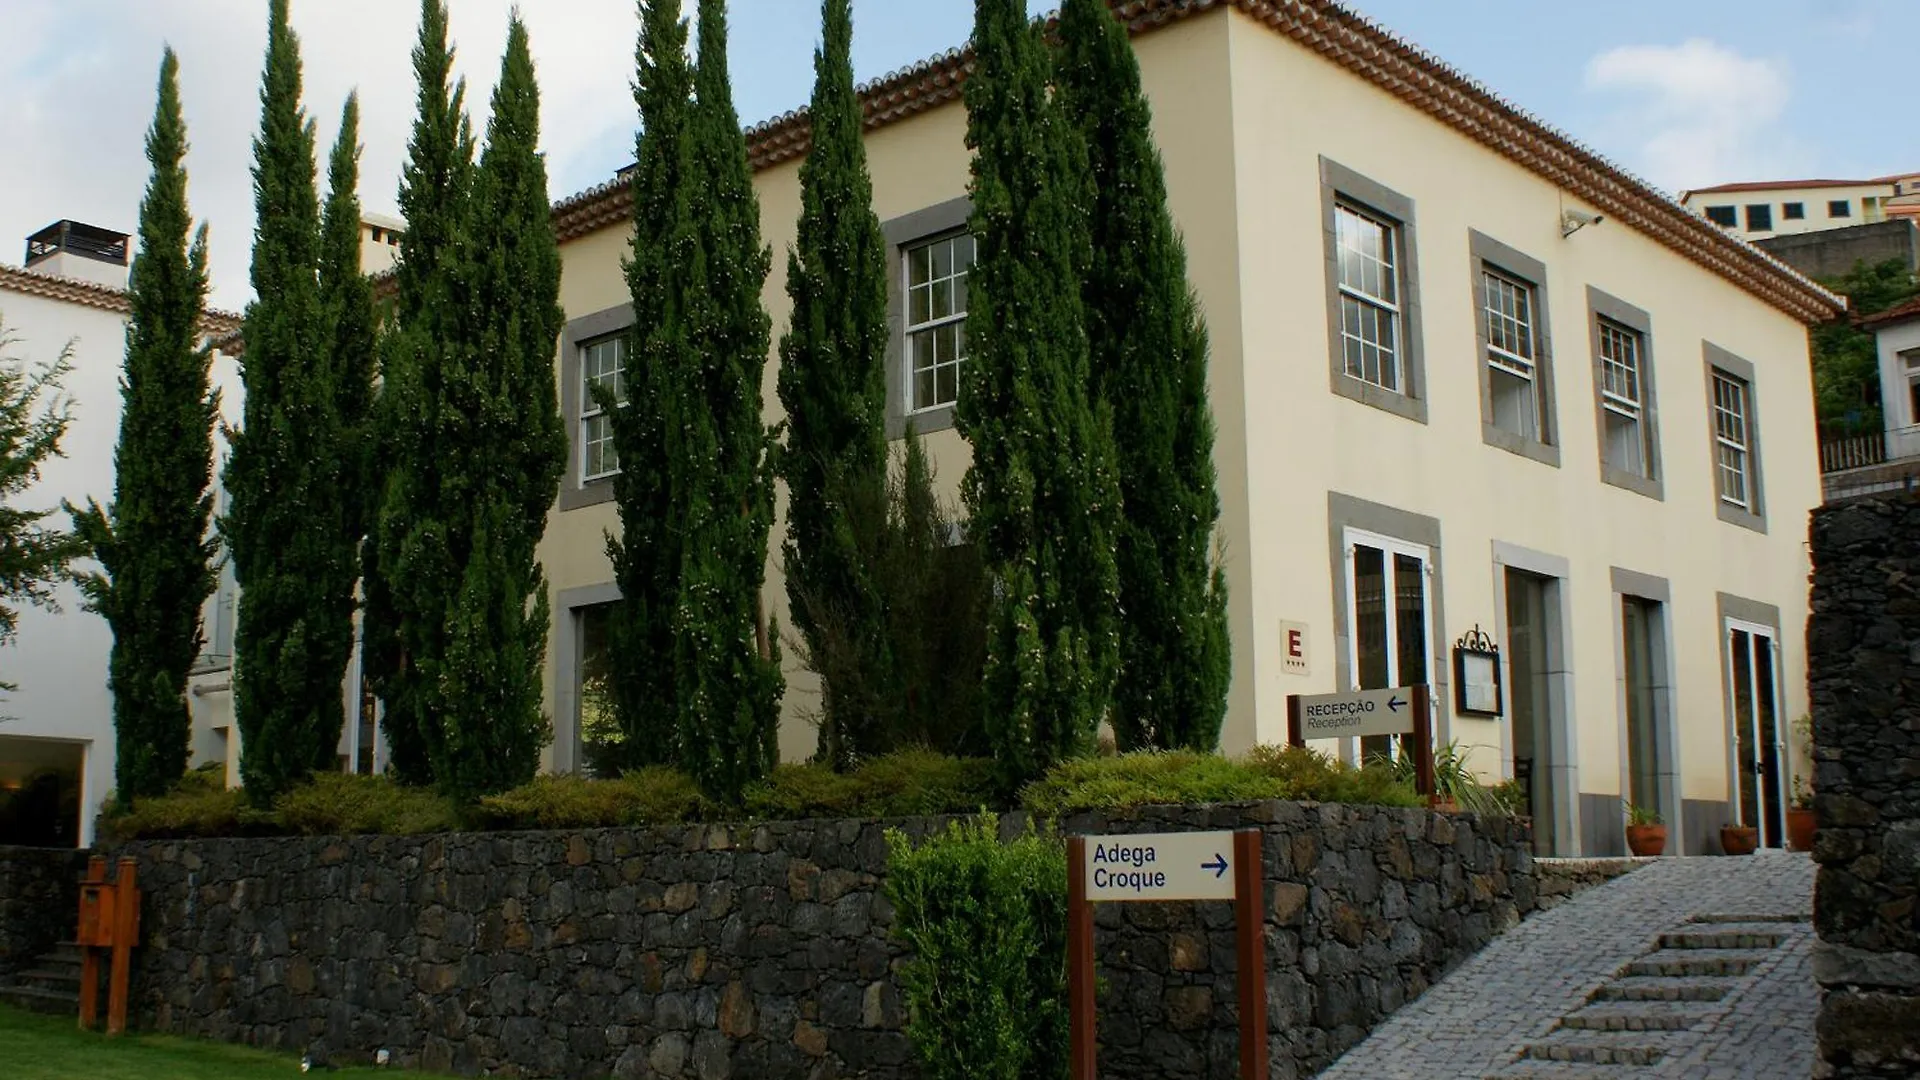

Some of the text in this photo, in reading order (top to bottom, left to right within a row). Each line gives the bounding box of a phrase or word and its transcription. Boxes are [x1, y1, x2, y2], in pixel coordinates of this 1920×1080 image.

[1289, 630, 1301, 657] E
[1306, 700, 1375, 717] RECEPÇÃO
[1307, 716, 1361, 729] Reception
[1093, 843, 1156, 867] Adega
[1094, 868, 1166, 892] Croque
